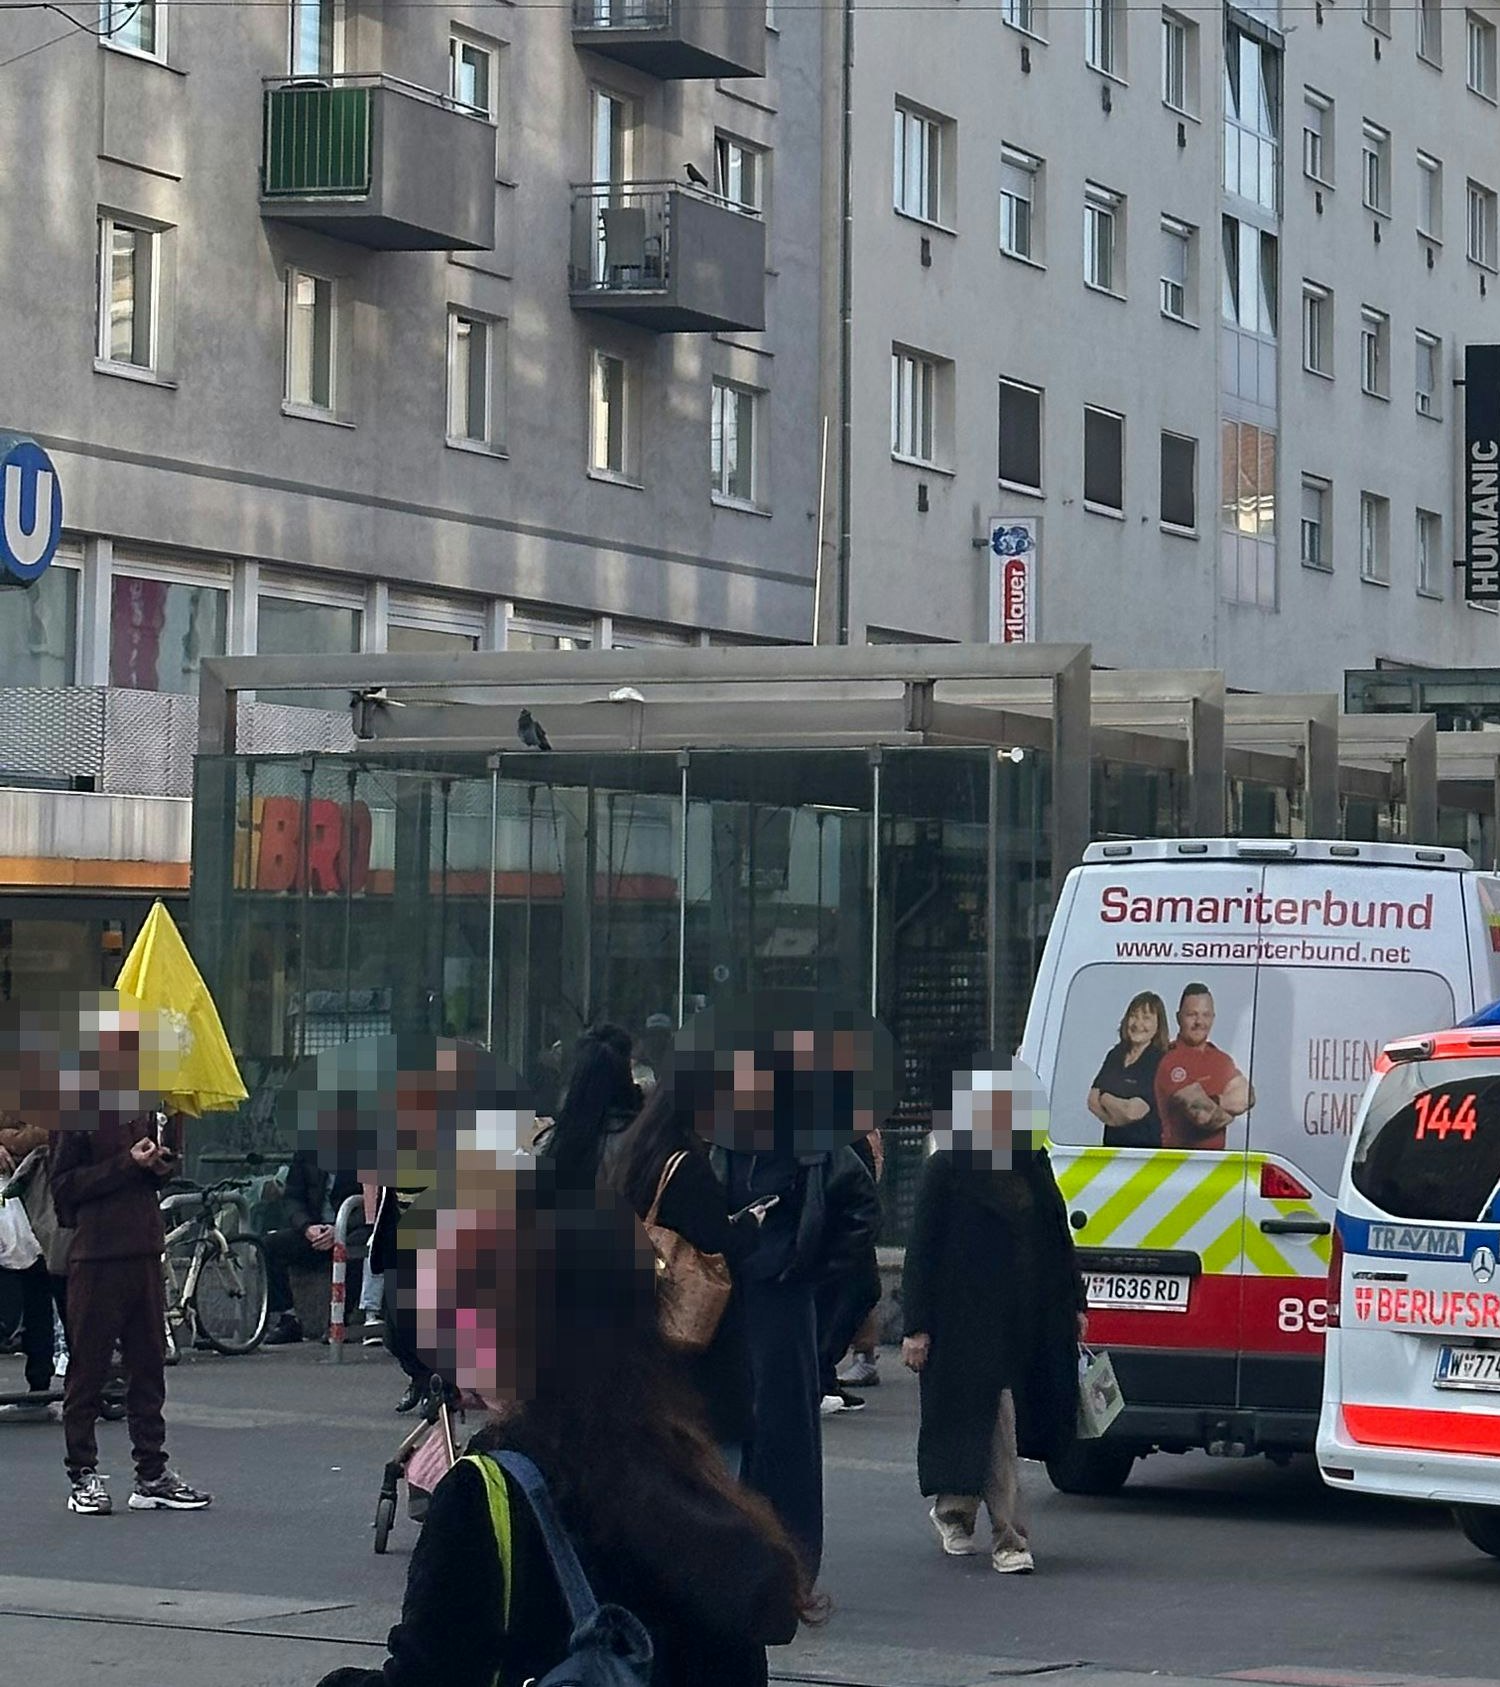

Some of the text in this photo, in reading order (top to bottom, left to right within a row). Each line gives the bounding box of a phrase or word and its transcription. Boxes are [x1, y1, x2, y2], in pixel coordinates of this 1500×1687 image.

[4, 464, 53, 565] U
[1472, 440, 1498, 592] HUMANIC
[1100, 887, 1433, 929] Samariterbund
[1116, 939, 1411, 963] www.samariterbund.net
[1308, 1039, 1378, 1081] HELFEN
[1304, 1091, 1364, 1135] GEME
[1415, 1093, 1477, 1139] 144
[1107, 1278, 1152, 1299] 1636
[1155, 1280, 1179, 1301] RD
[1450, 1354, 1464, 1376] W
